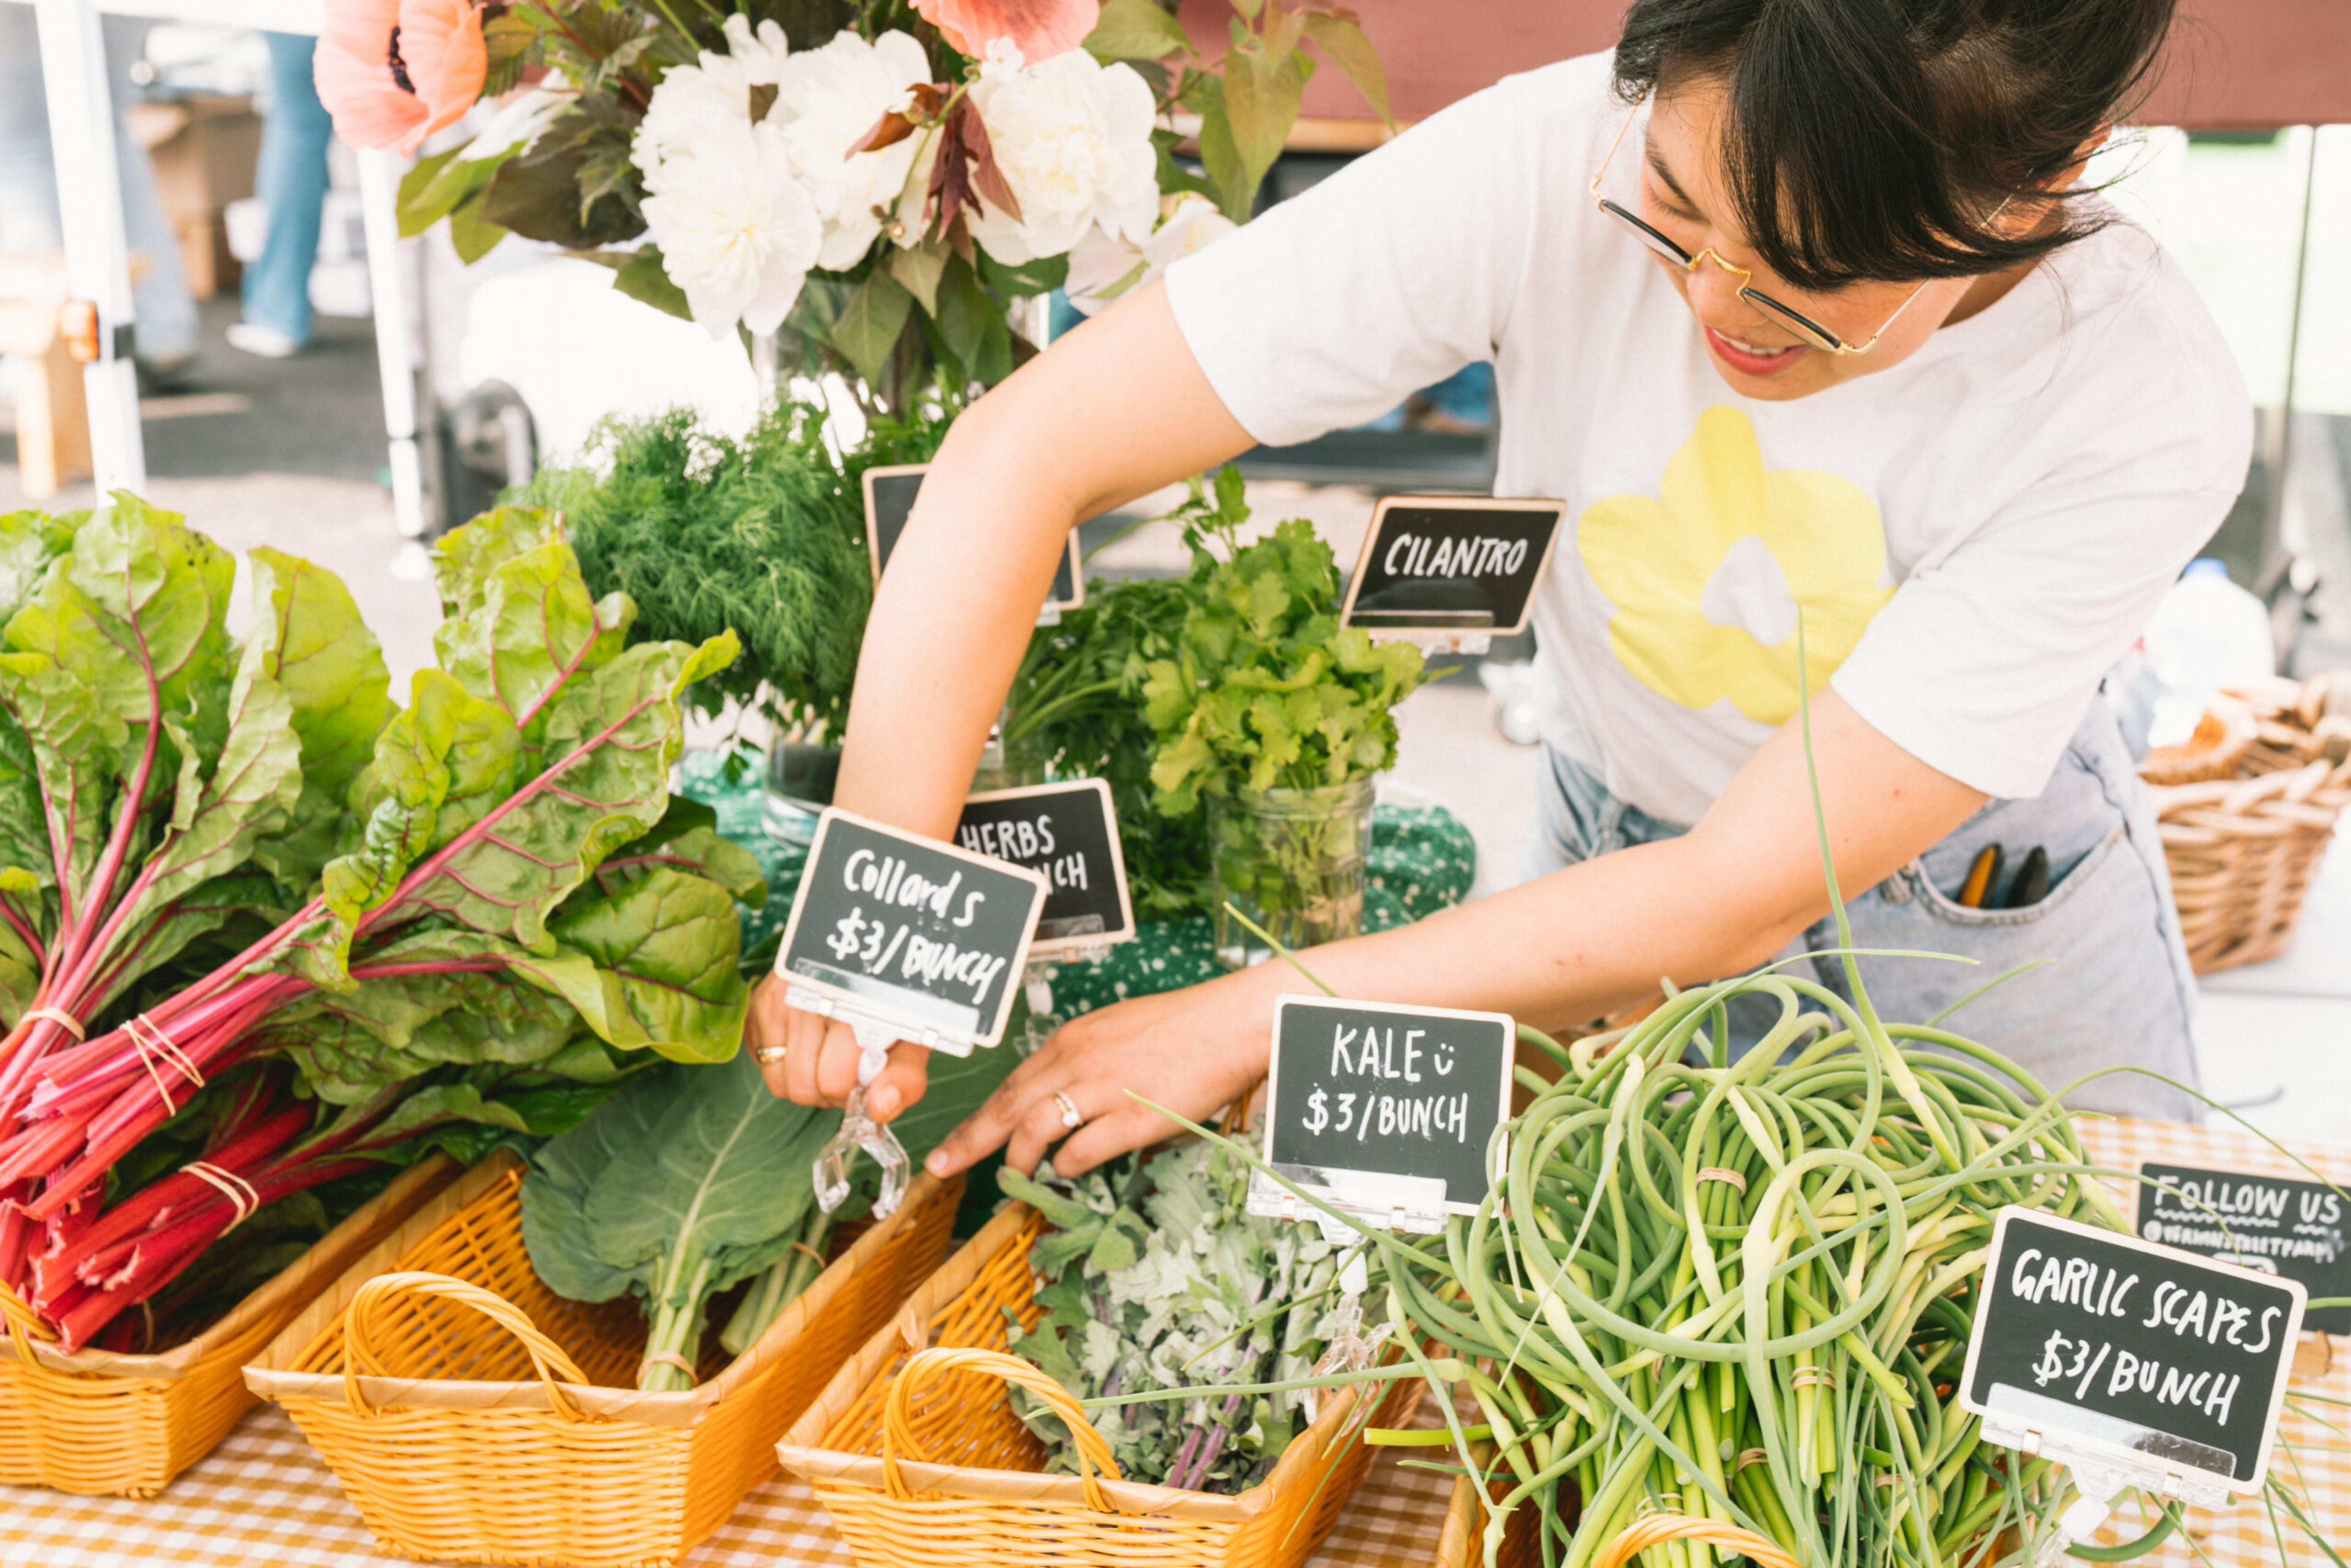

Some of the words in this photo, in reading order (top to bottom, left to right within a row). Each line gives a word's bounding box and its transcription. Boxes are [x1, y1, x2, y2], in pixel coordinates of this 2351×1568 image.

[1384, 533, 1528, 578] CILANTRO
[961, 814, 1055, 860] HERBS
[826, 906, 1007, 1005] $3/BUNCH
[1330, 1023, 1426, 1083] KALE
[1302, 1087, 1469, 1144] $3/BUNCH
[2154, 1174, 2290, 1218] FOLLOW
[2300, 1190, 2342, 1225] US
[2012, 1248, 2140, 1318] GARLIC
[2142, 1280, 2282, 1354] SCAPES
[2031, 1329, 2241, 1427] $3/BUNCH
